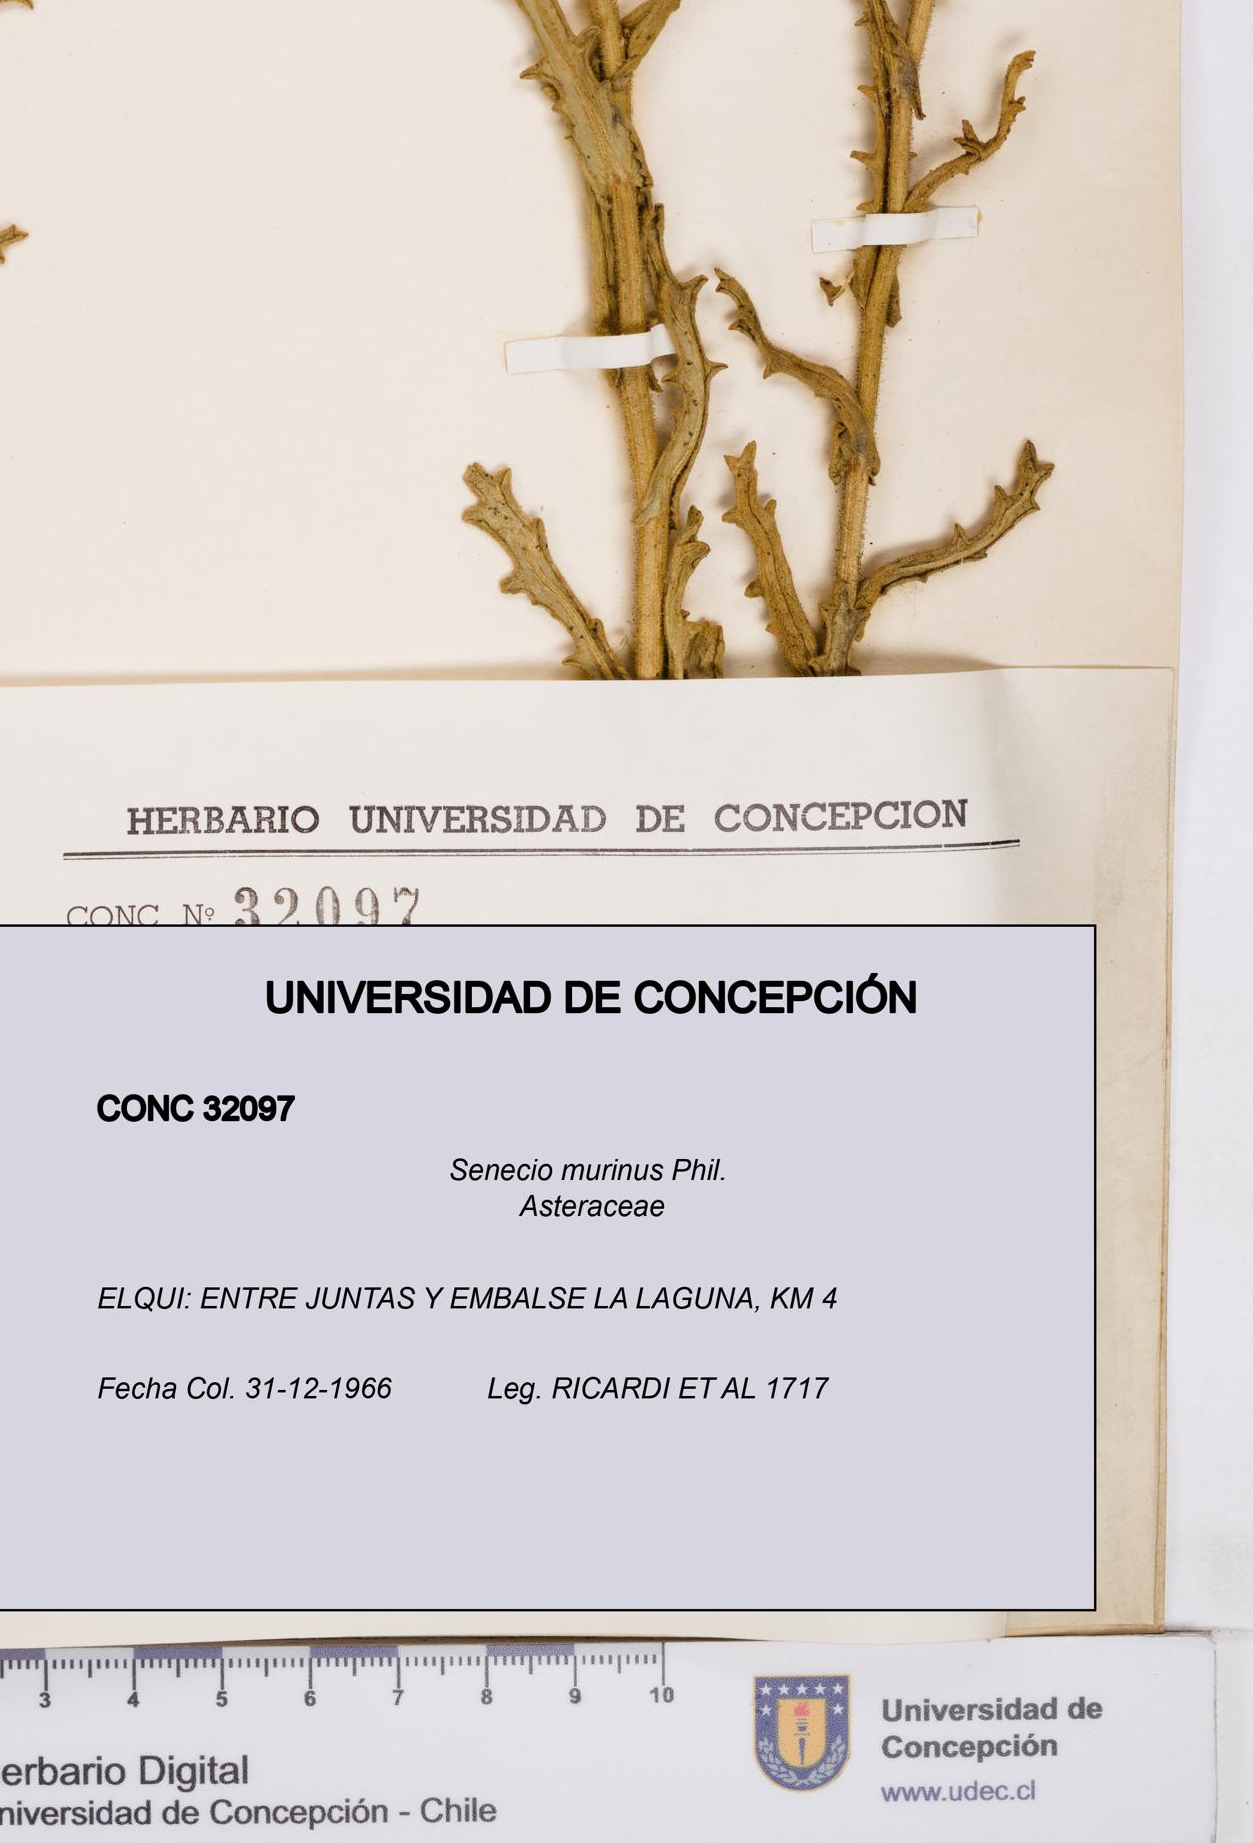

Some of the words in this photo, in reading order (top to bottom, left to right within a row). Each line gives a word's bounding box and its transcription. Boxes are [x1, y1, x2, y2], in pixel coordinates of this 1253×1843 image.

[126, 804, 320, 836] HERBARIO
[348, 803, 607, 835] UNIVERSIDAD
[635, 803, 686, 833] DE
[714, 797, 969, 833] CONCEPCION
[66, 904, 159, 925] CONC
[38, 1692, 52, 1709] 3
[126, 1691, 141, 1708] 4
[215, 1691, 229, 1708] 5
[303, 1690, 317, 1707] 6
[392, 1689, 405, 1706] 7
[480, 1689, 494, 1706] 8
[568, 1688, 582, 1705] 9
[649, 1687, 675, 1704] 10
[882, 1696, 1058, 1723] Universidad
[1067, 1695, 1104, 1720] de
[881, 1732, 1058, 1764] Concepción
[139, 1754, 249, 1793] Digital
[880, 1779, 1036, 1802] www.udec.cl
[161, 1797, 200, 1826] de
[209, 1797, 389, 1831] Concepción
[420, 1796, 498, 1824] Chile
